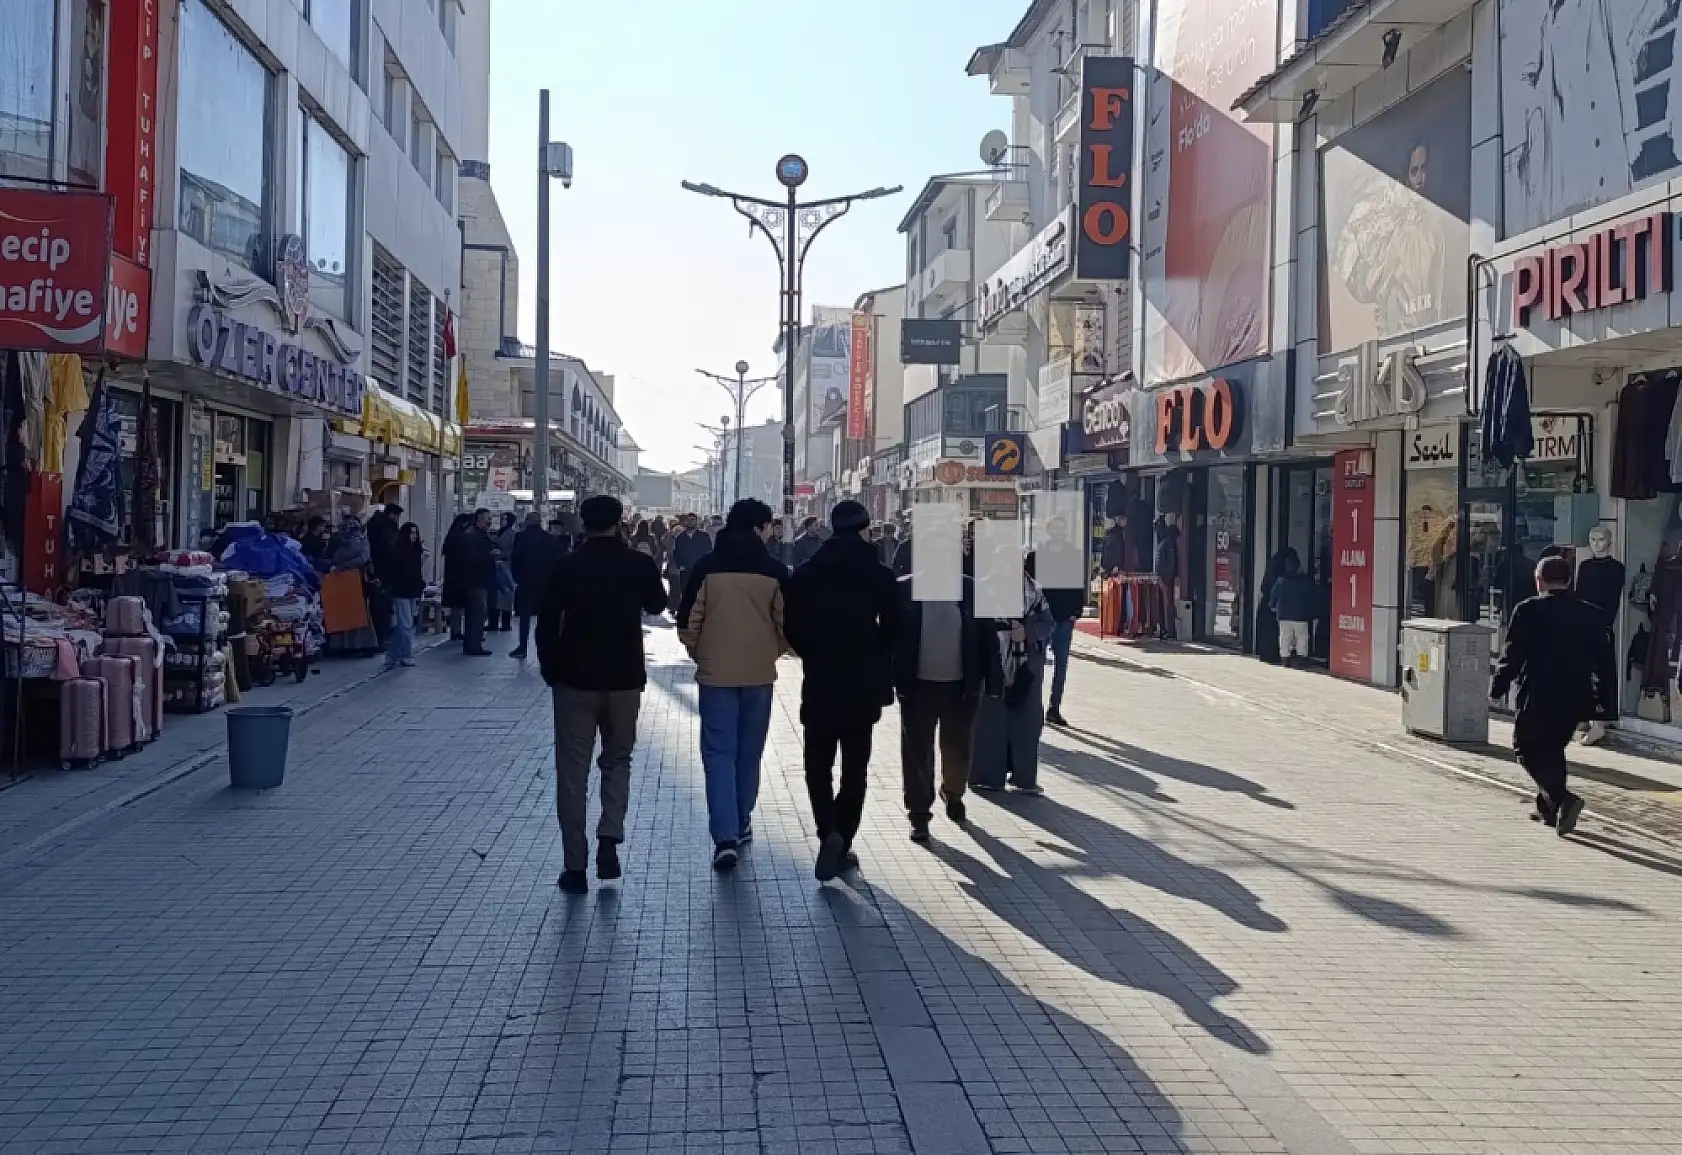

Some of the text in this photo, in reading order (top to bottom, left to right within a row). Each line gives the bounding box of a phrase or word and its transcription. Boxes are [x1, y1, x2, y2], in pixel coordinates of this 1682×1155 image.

[1084, 87, 1129, 245] FLO
[1514, 212, 1668, 328] PIRILTI
[1155, 377, 1233, 454] FLO
[1351, 507, 1358, 543] 1
[1349, 573, 1357, 608] 1
